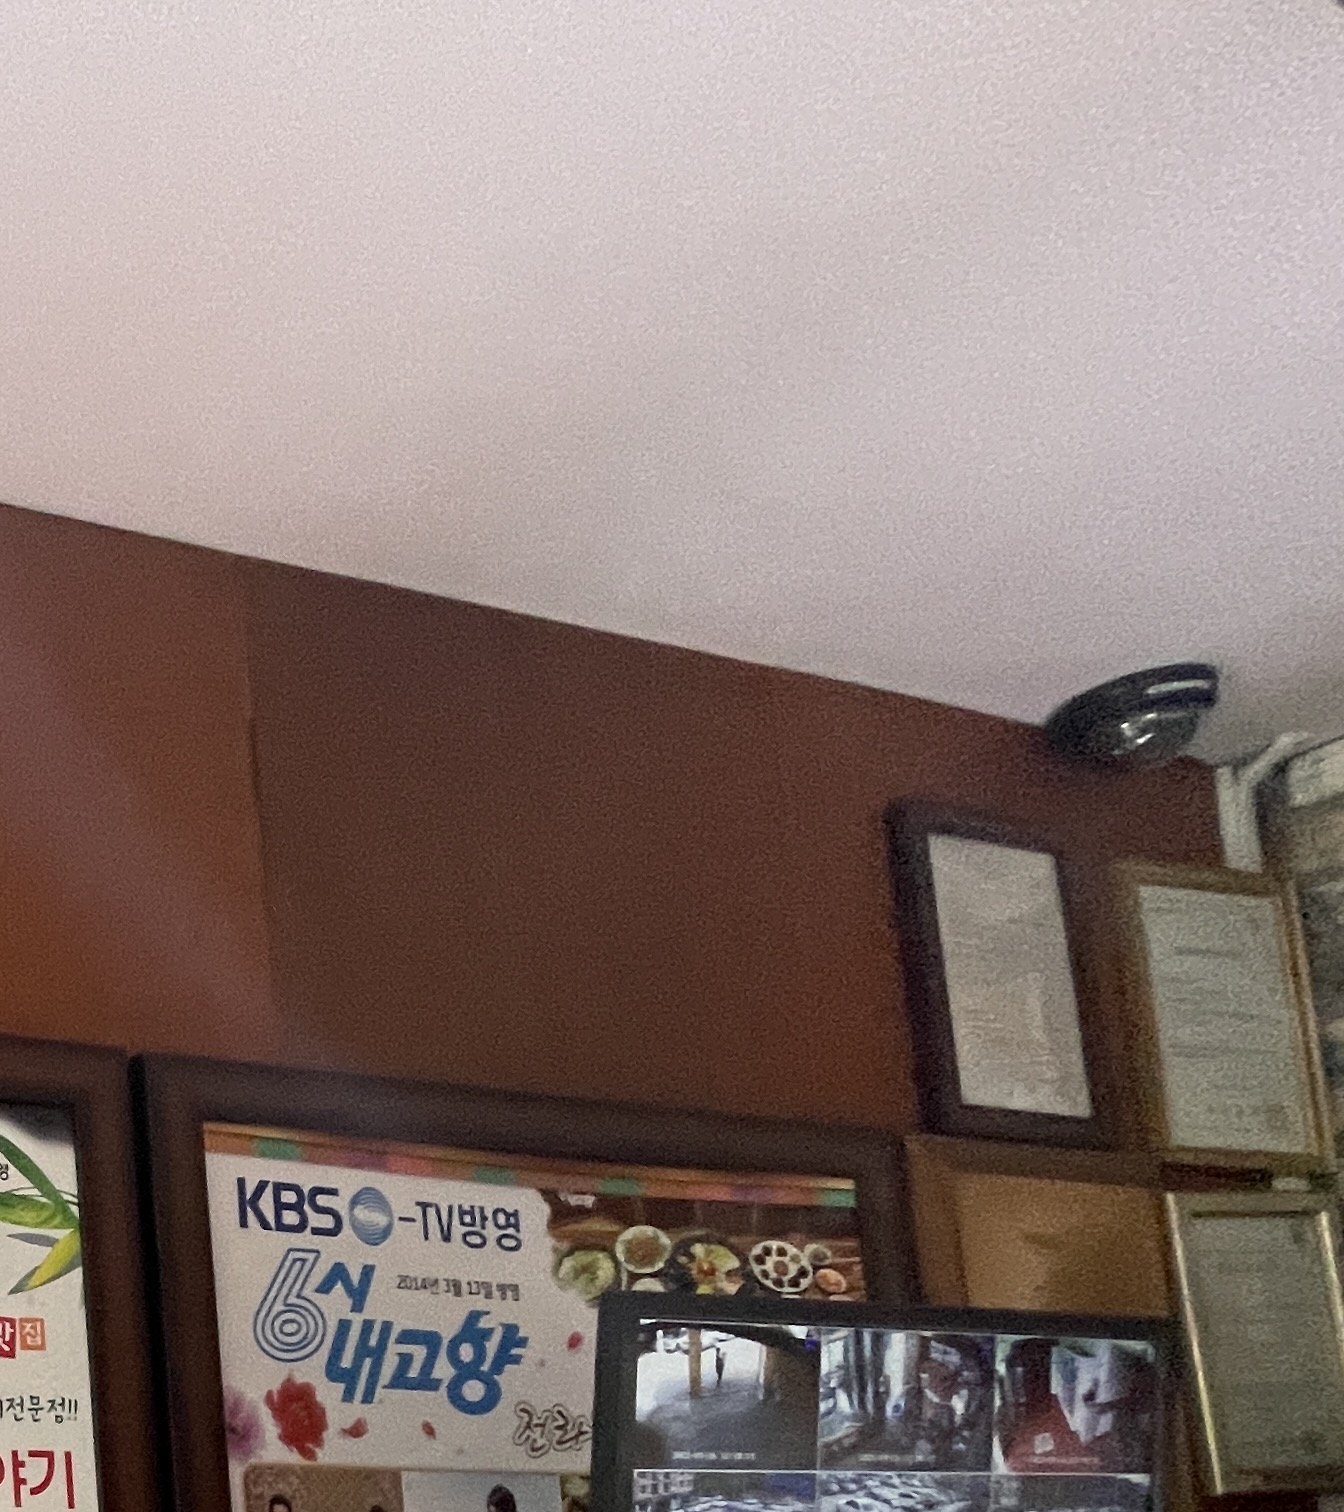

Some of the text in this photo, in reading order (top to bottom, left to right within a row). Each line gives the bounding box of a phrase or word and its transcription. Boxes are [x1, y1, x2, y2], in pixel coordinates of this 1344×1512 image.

[237, 1176, 343, 1237] KBS
[253, 1248, 376, 1362] 6시
[325, 1310, 528, 1416] 내고향
[514, 1402, 592, 1459] 전라
